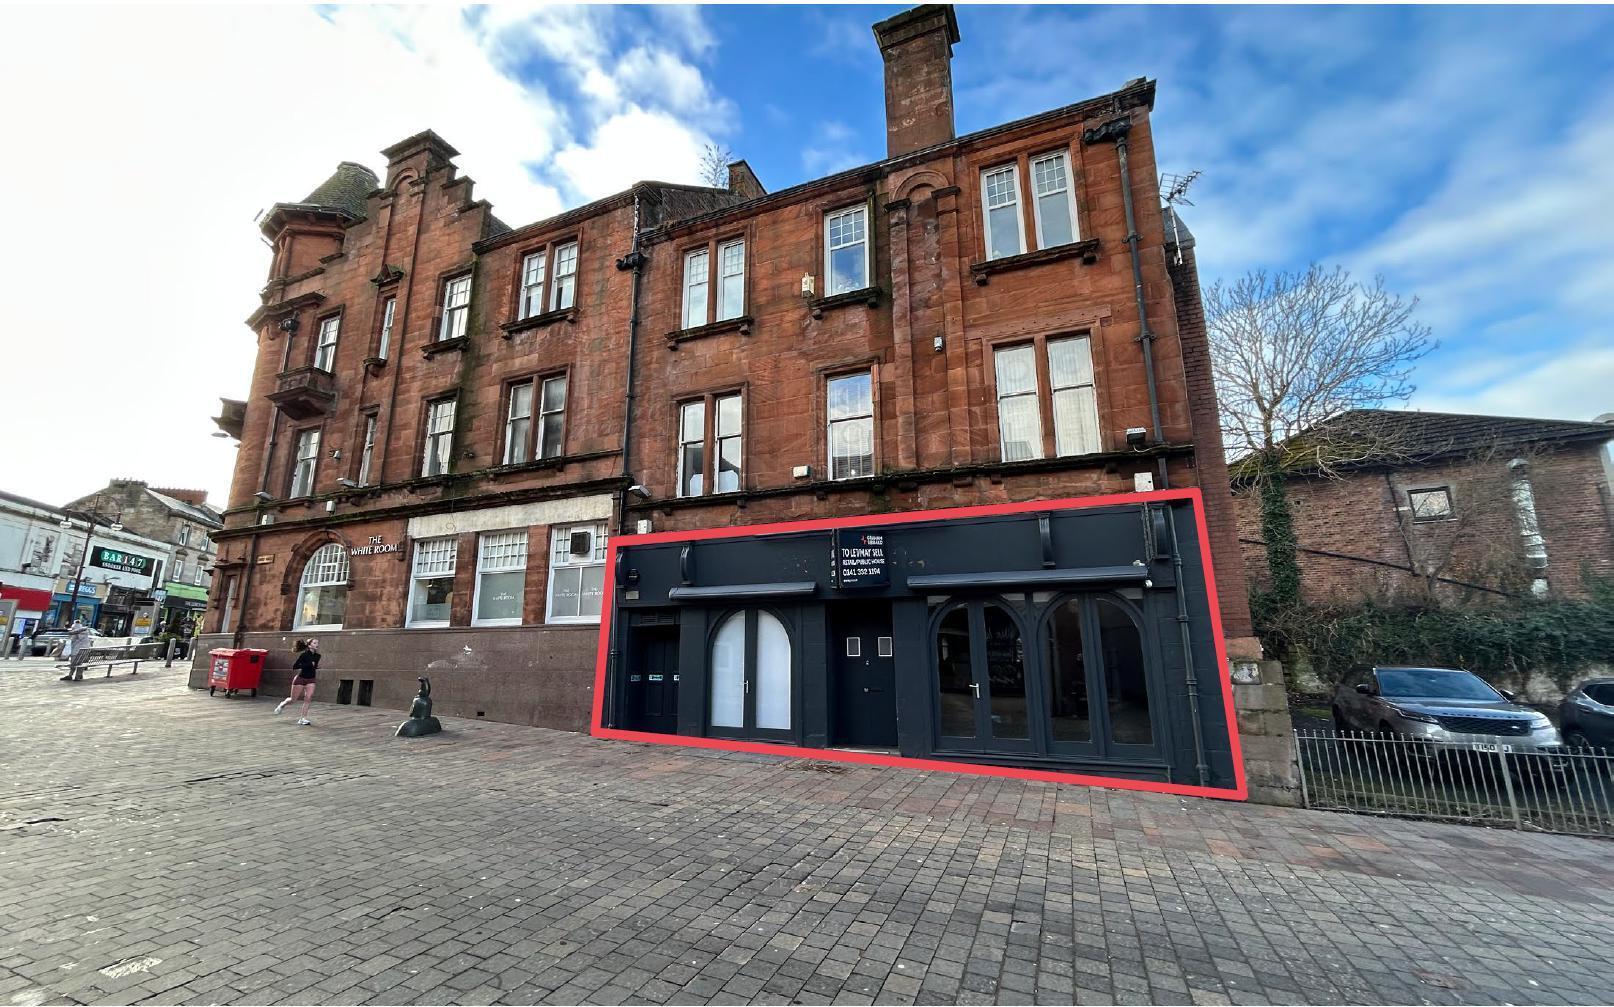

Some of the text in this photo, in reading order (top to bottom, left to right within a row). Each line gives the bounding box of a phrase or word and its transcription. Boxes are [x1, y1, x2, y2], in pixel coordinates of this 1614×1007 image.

[368, 535, 383, 544] THE
[351, 543, 397, 556] WHITE ROOM
[842, 548, 850, 558] TO
[872, 548, 884, 557] SELL
[843, 568, 857, 576] 0141
